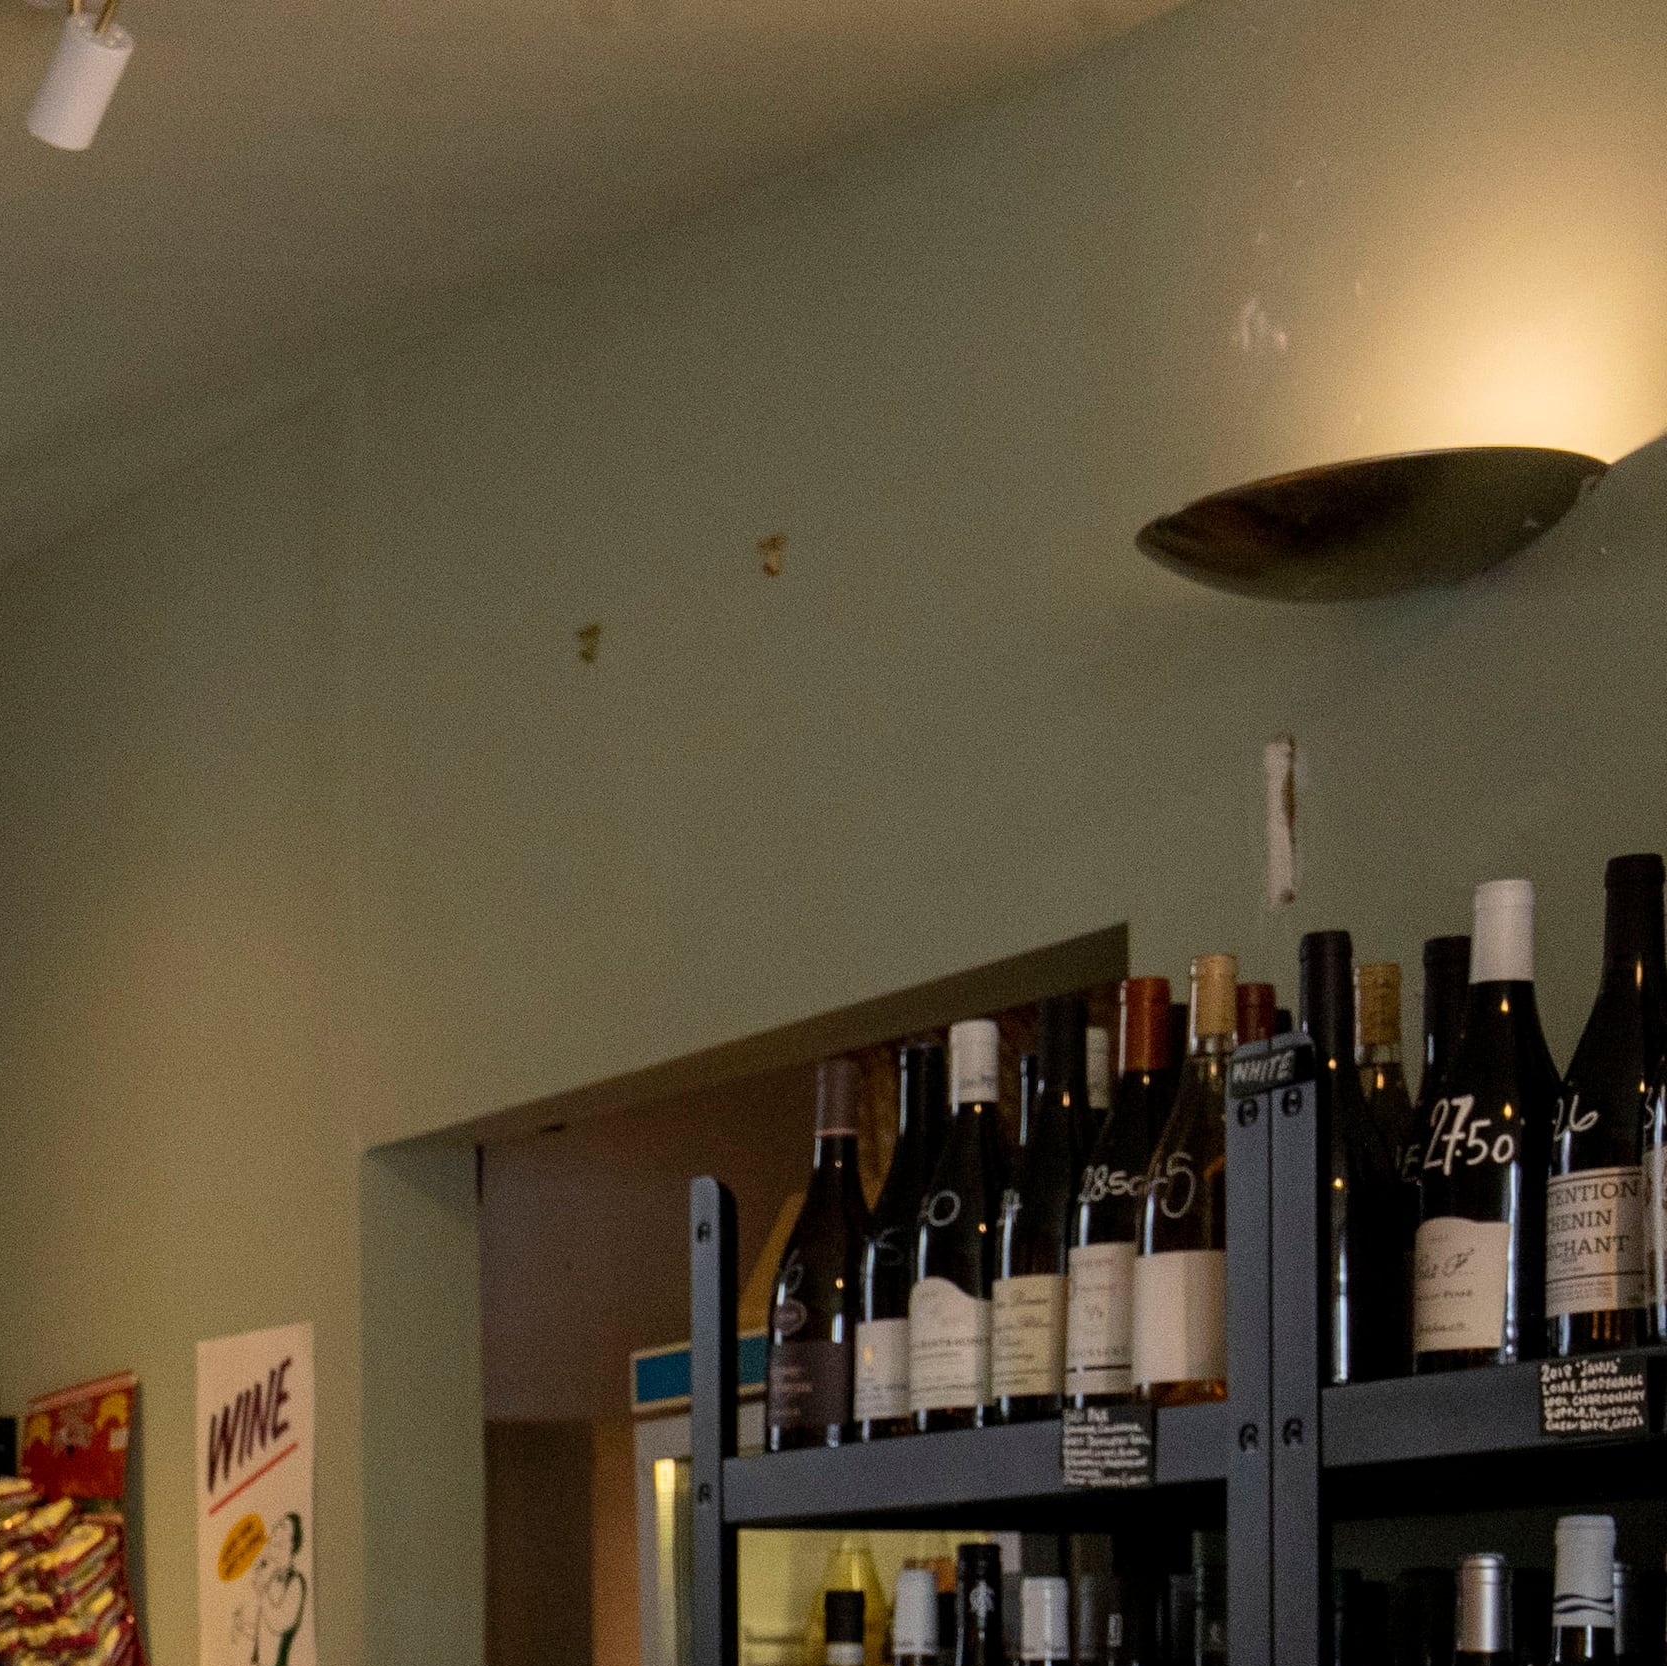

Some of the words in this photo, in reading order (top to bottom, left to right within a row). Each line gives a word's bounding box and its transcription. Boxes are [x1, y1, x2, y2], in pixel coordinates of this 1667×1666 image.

[1232, 1049, 1295, 1084] WHITE
[1423, 1093, 1515, 1176] 27.50
[208, 1357, 294, 1494] WINE
